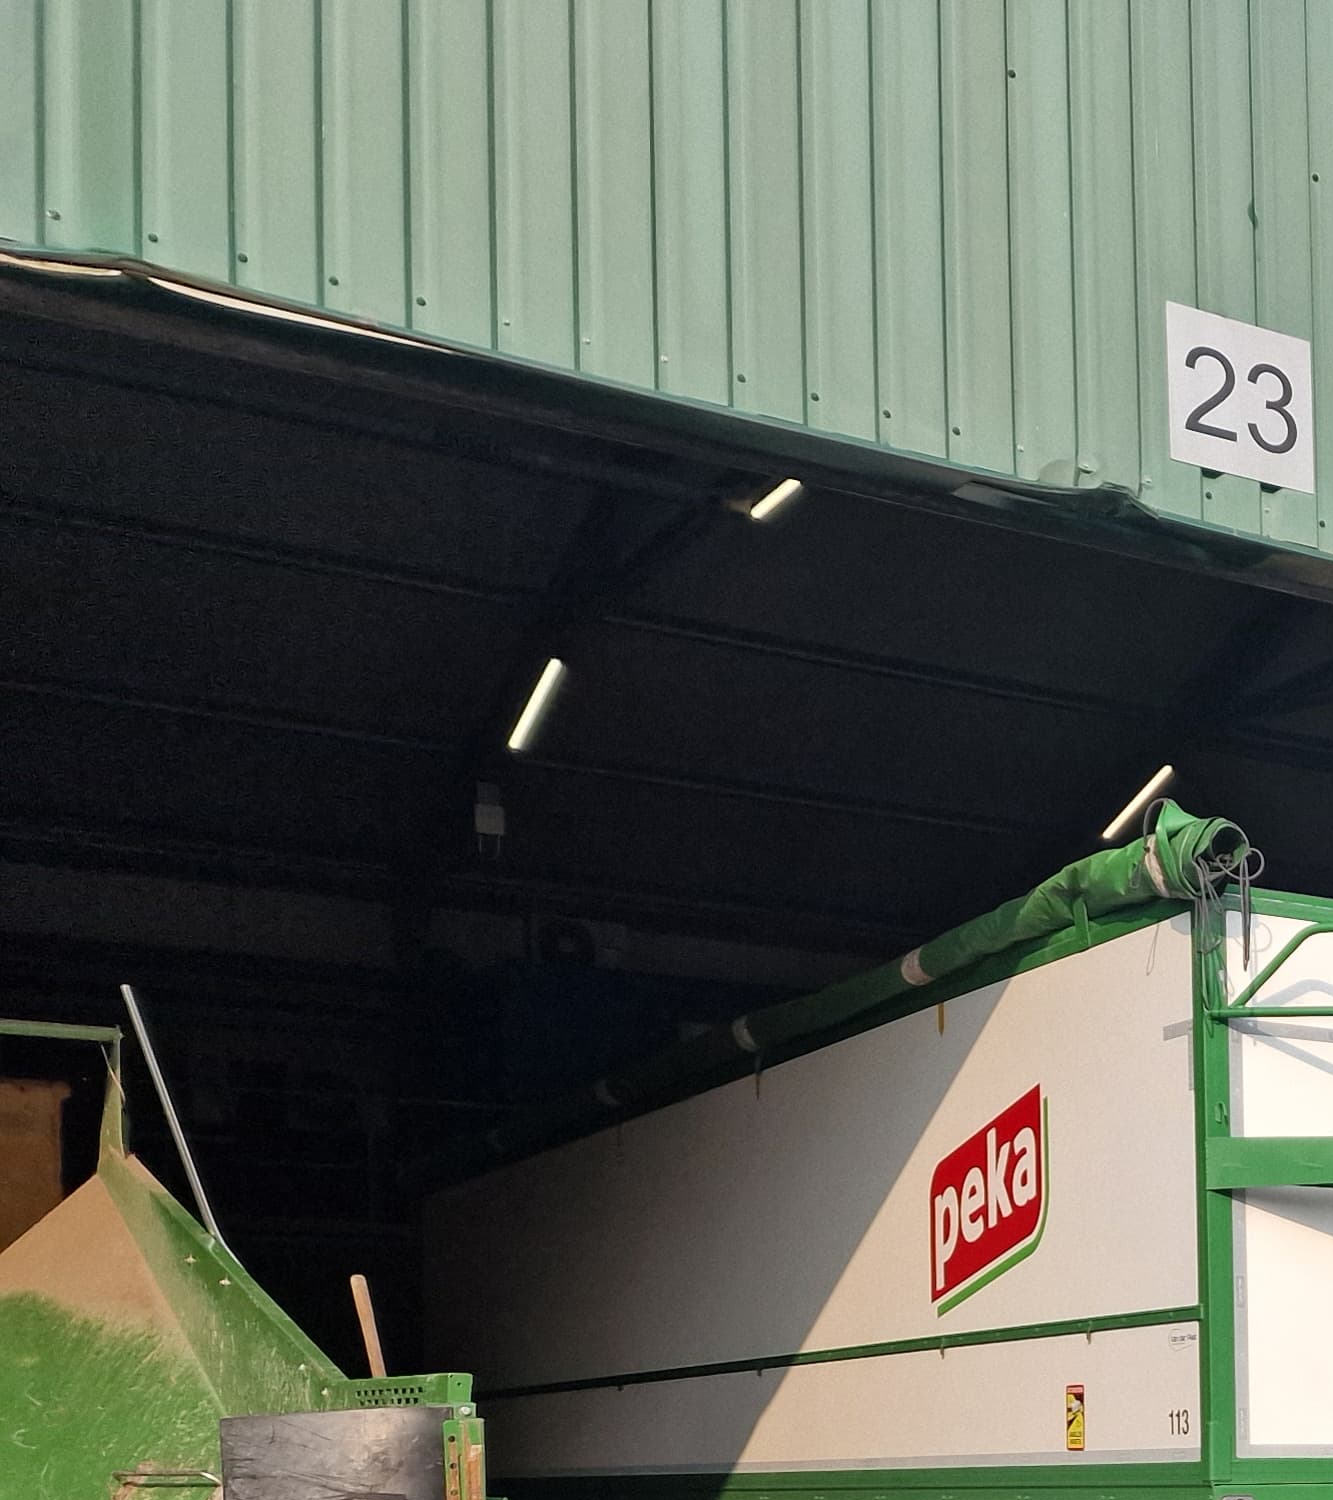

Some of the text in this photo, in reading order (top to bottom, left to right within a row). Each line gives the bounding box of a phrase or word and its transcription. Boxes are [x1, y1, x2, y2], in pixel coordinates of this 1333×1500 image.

[1185, 346, 1298, 454] 23
[934, 1126, 1037, 1291] peka
[1168, 1408, 1190, 1436] 113
